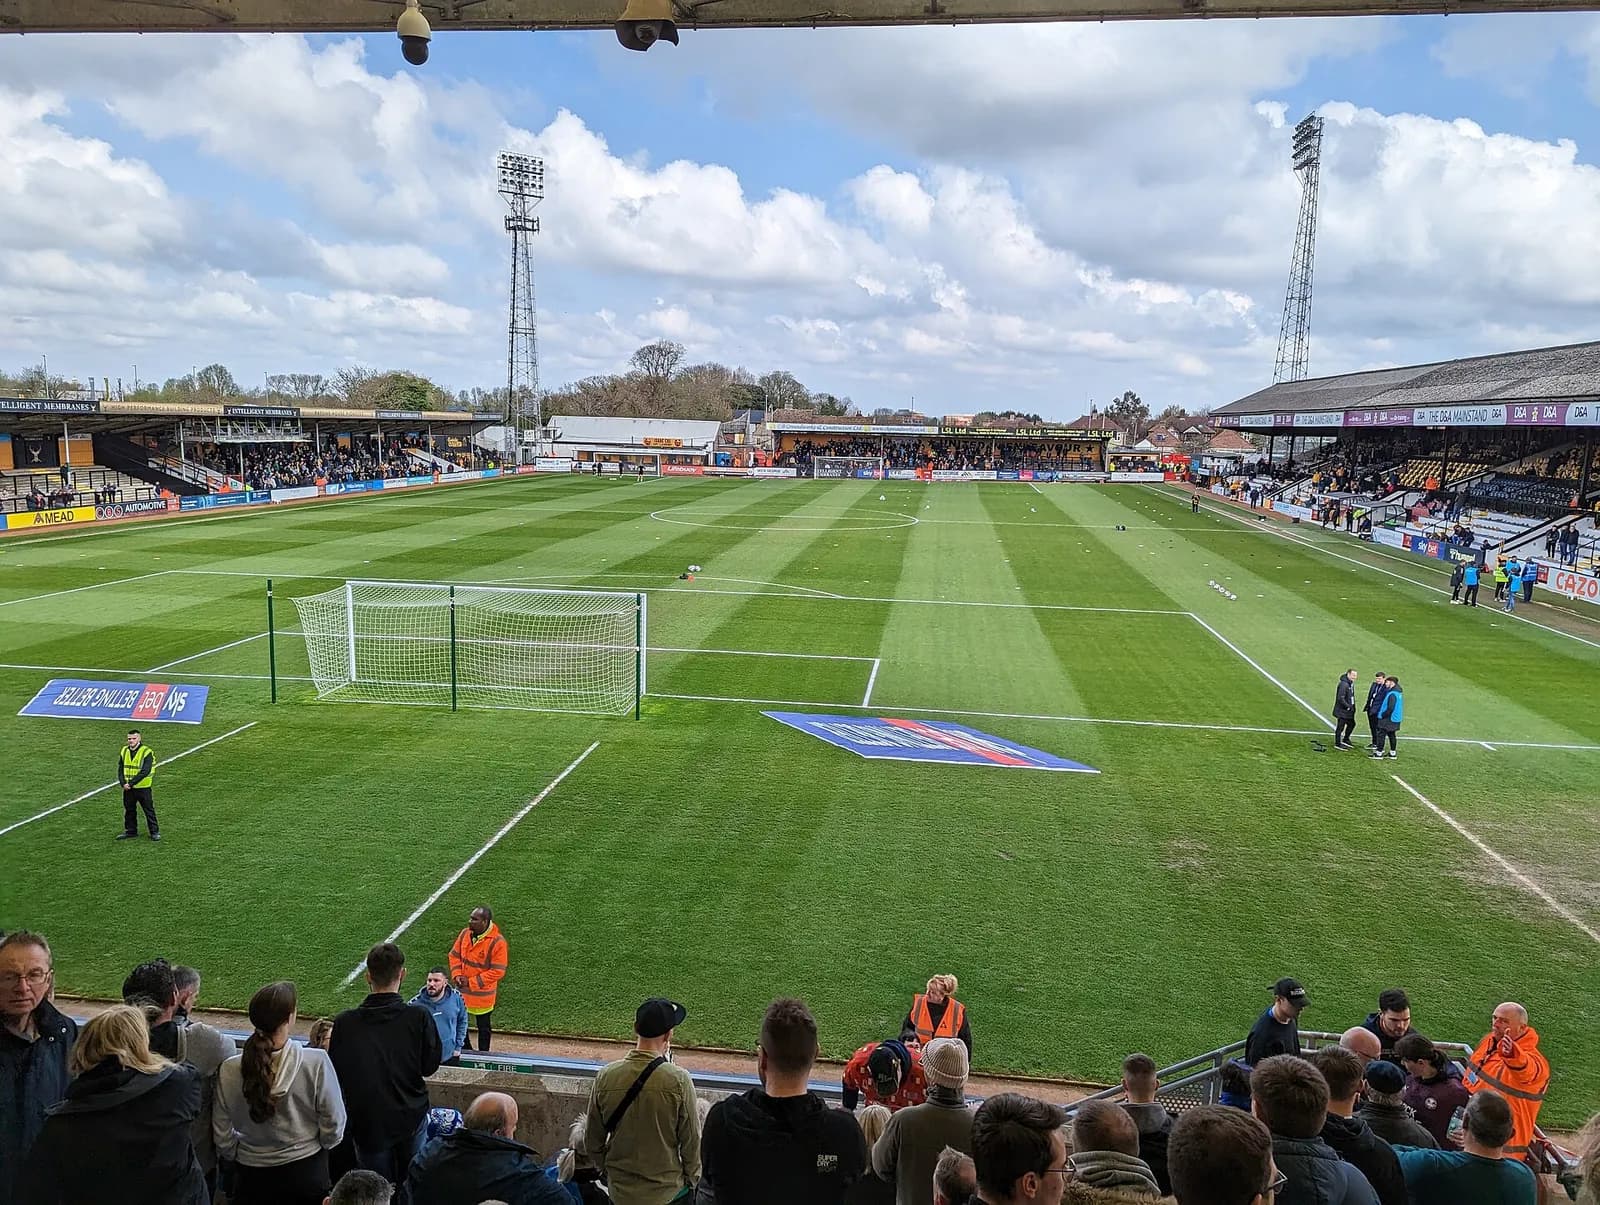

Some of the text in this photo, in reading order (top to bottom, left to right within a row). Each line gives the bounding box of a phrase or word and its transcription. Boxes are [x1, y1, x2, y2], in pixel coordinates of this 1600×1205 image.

[44, 403, 90, 411] MEMBRANES
[1574, 406, 1587, 418] D&A
[1491, 409, 1502, 418] D&A
[1029, 428, 1042, 436] Ltd
[125, 501, 166, 512] AUTOMOTIVE
[45, 511, 74, 524] MEAD
[1556, 571, 1598, 599] CAZO
[53, 686, 188, 717] sky bet BETTING BETTER
[817, 1154, 838, 1162] SUPER
